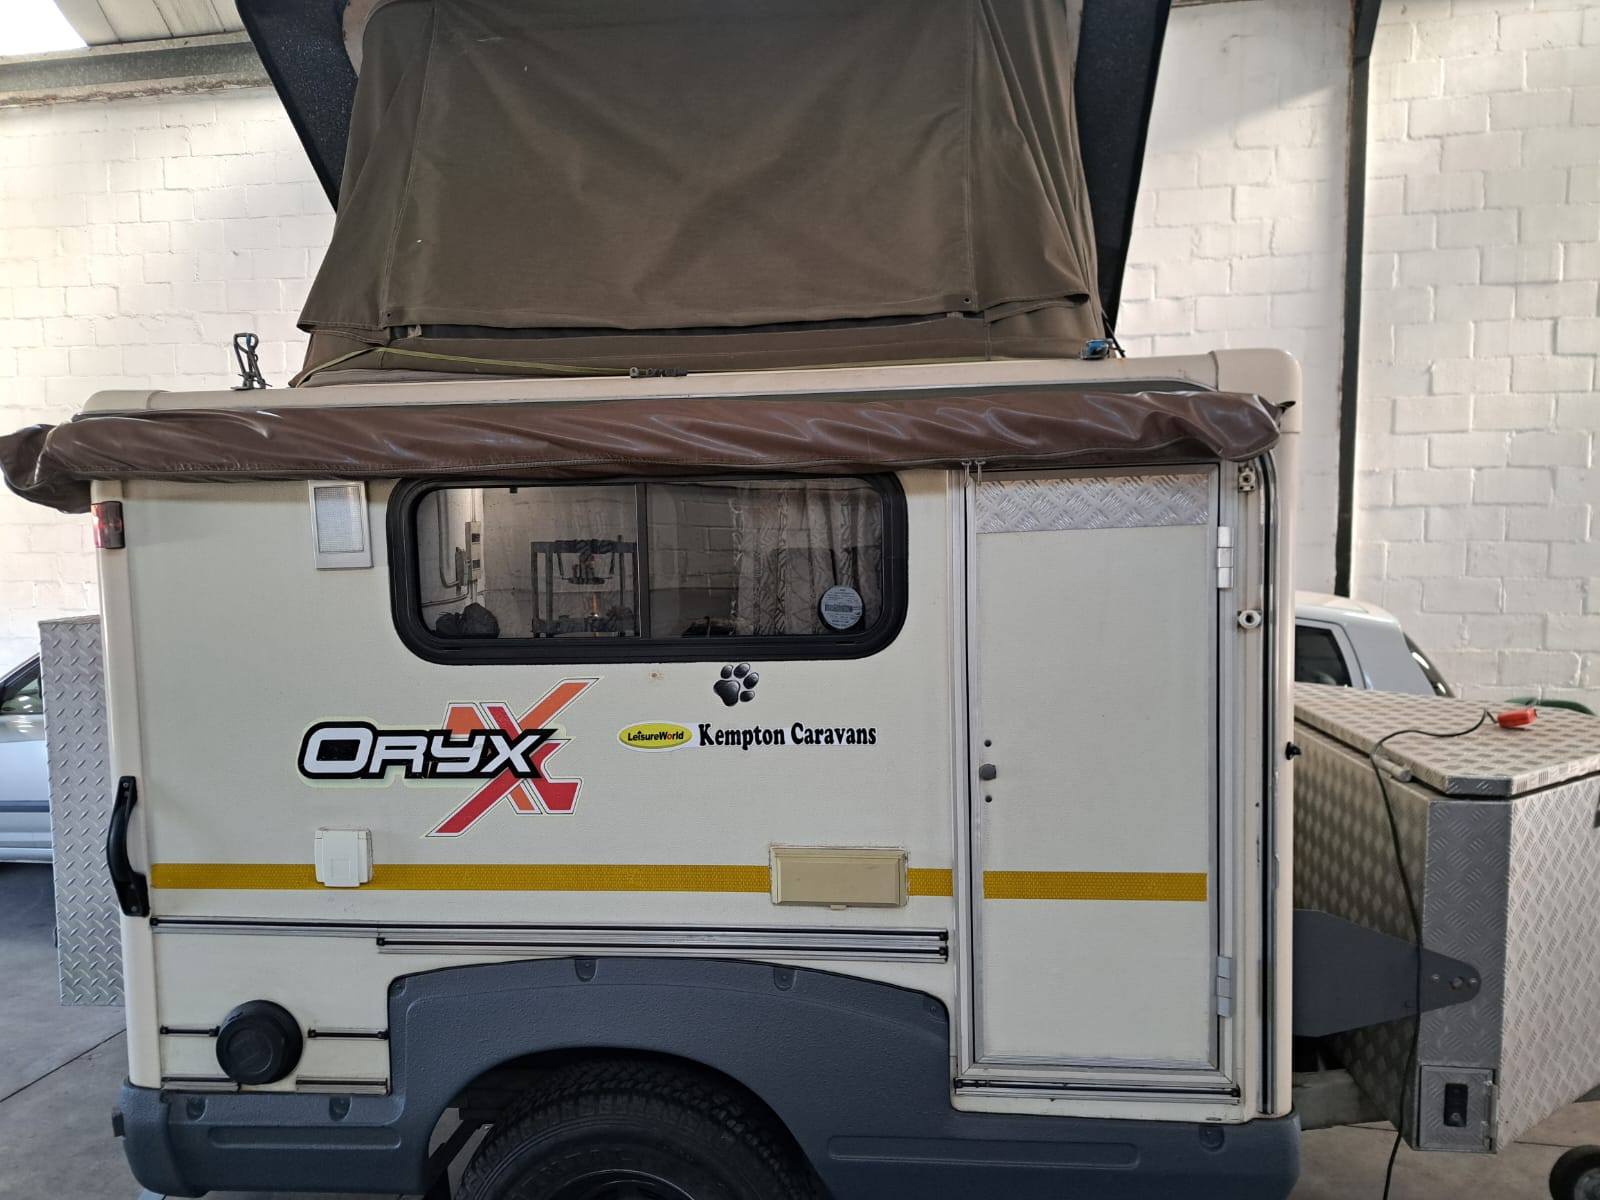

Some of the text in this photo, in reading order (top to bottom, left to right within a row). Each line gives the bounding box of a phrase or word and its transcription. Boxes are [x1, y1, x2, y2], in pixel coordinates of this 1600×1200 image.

[627, 722, 877, 751] LeisureWorld Kempton Caravans
